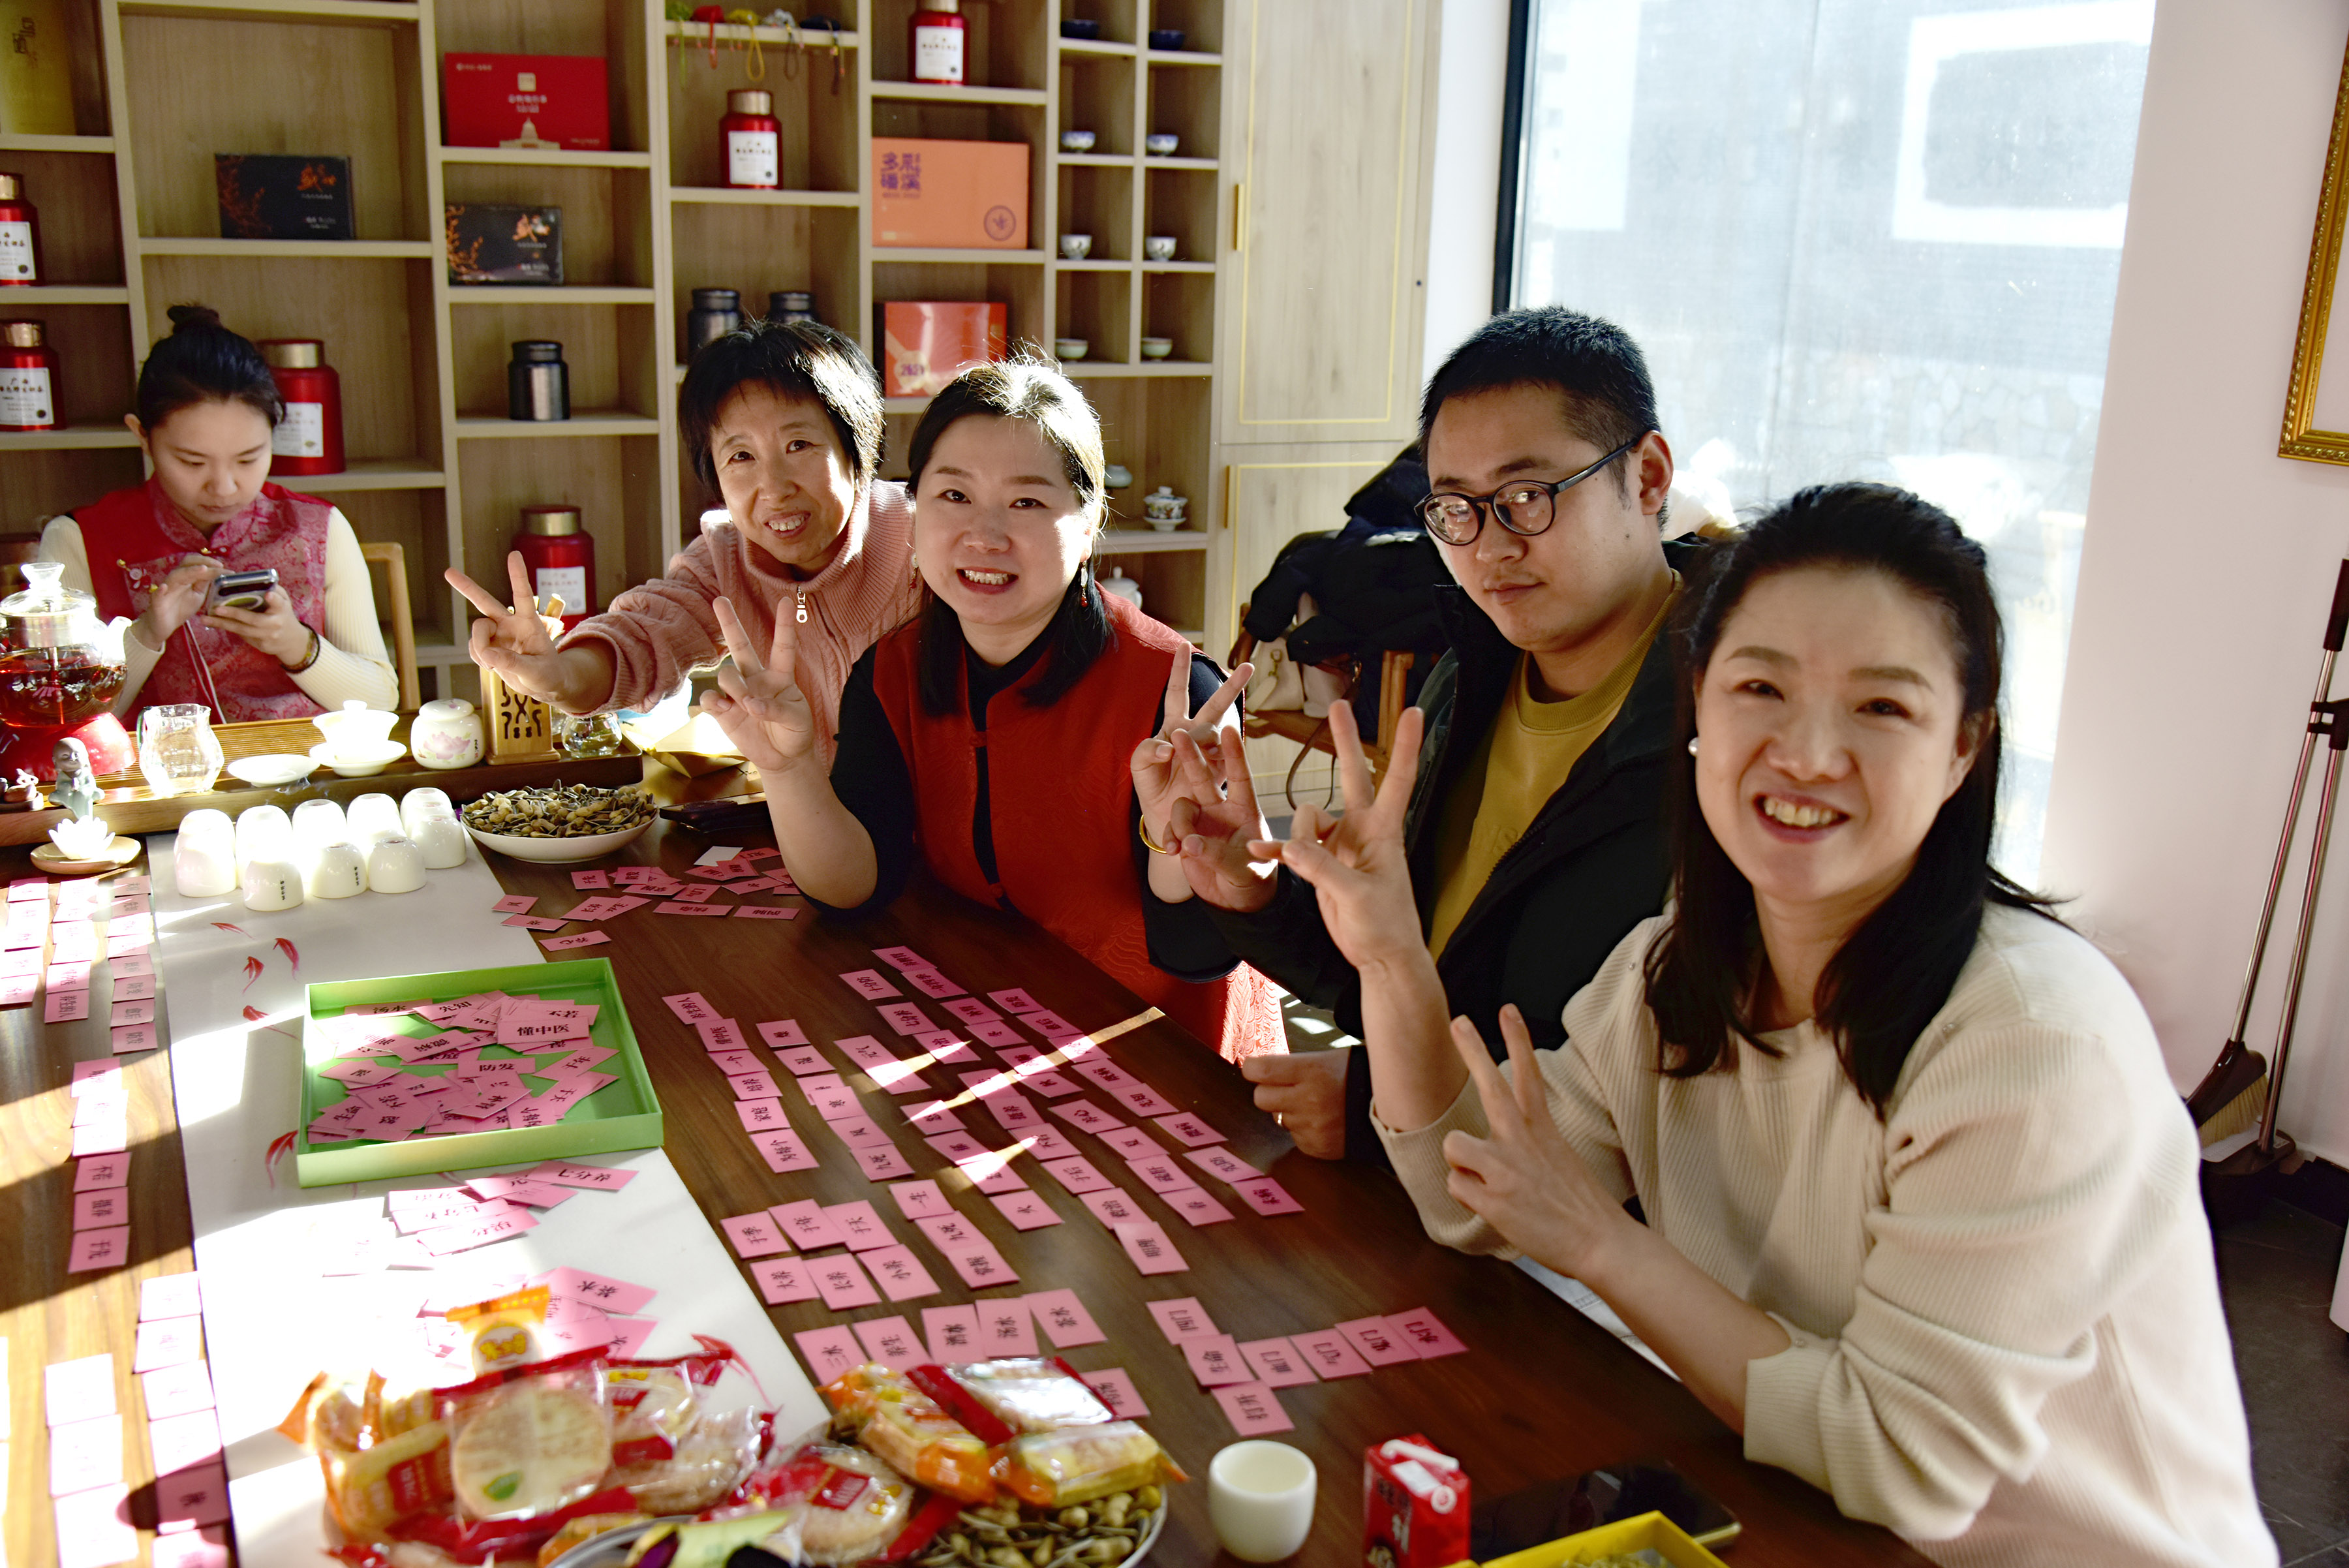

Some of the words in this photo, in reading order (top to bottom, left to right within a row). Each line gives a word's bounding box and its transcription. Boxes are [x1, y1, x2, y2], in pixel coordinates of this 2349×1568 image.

[856, 976, 883, 992] 十分防
[915, 972, 947, 993] 一年四季
[57, 994, 77, 1018] 养生的人
[438, 1001, 472, 1012] 先知
[677, 996, 707, 1019] 养生的人
[1004, 995, 1029, 1007] 防发
[546, 1009, 579, 1018] 不若
[893, 1009, 920, 1027] 七分养
[516, 1023, 570, 1036] 懂中医
[709, 1026, 733, 1045] 懂中医
[414, 1038, 450, 1051] 微病
[855, 1045, 879, 1058] 元气
[479, 1063, 516, 1071] 防发
[725, 1054, 743, 1068] 一个
[741, 1078, 763, 1092] 培养
[378, 1094, 408, 1109] 不若
[828, 1099, 846, 1108] 寒
[1129, 1092, 1156, 1107] 先知
[750, 1106, 772, 1122] 家庭
[1073, 1109, 1100, 1123] 养心
[769, 1139, 797, 1162] 为每个
[868, 1153, 893, 1170] 九死
[1209, 1156, 1239, 1173] 先防
[88, 1163, 114, 1180] 不若
[558, 1168, 612, 1182] 七分养
[908, 1190, 928, 1208] 一生
[741, 1226, 768, 1244] 于季
[936, 1222, 966, 1241] 九死
[1136, 1237, 1161, 1257] 明理
[882, 1259, 912, 1280] 小养
[966, 1256, 995, 1276] 掌握
[577, 1280, 619, 1298] 茶水
[825, 1270, 854, 1290] 长养
[1049, 1306, 1078, 1328] 茶水
[1167, 1309, 1199, 1331] 四门
[942, 1323, 967, 1345] 酒水
[994, 1315, 1019, 1338] 汤水
[880, 1334, 909, 1357] 养生
[1312, 1342, 1342, 1365] 气门
[821, 1344, 850, 1368] 三水
[1201, 1350, 1229, 1373] 生命
[1259, 1350, 1292, 1373] 血门
[1236, 1393, 1268, 1420] 打开
